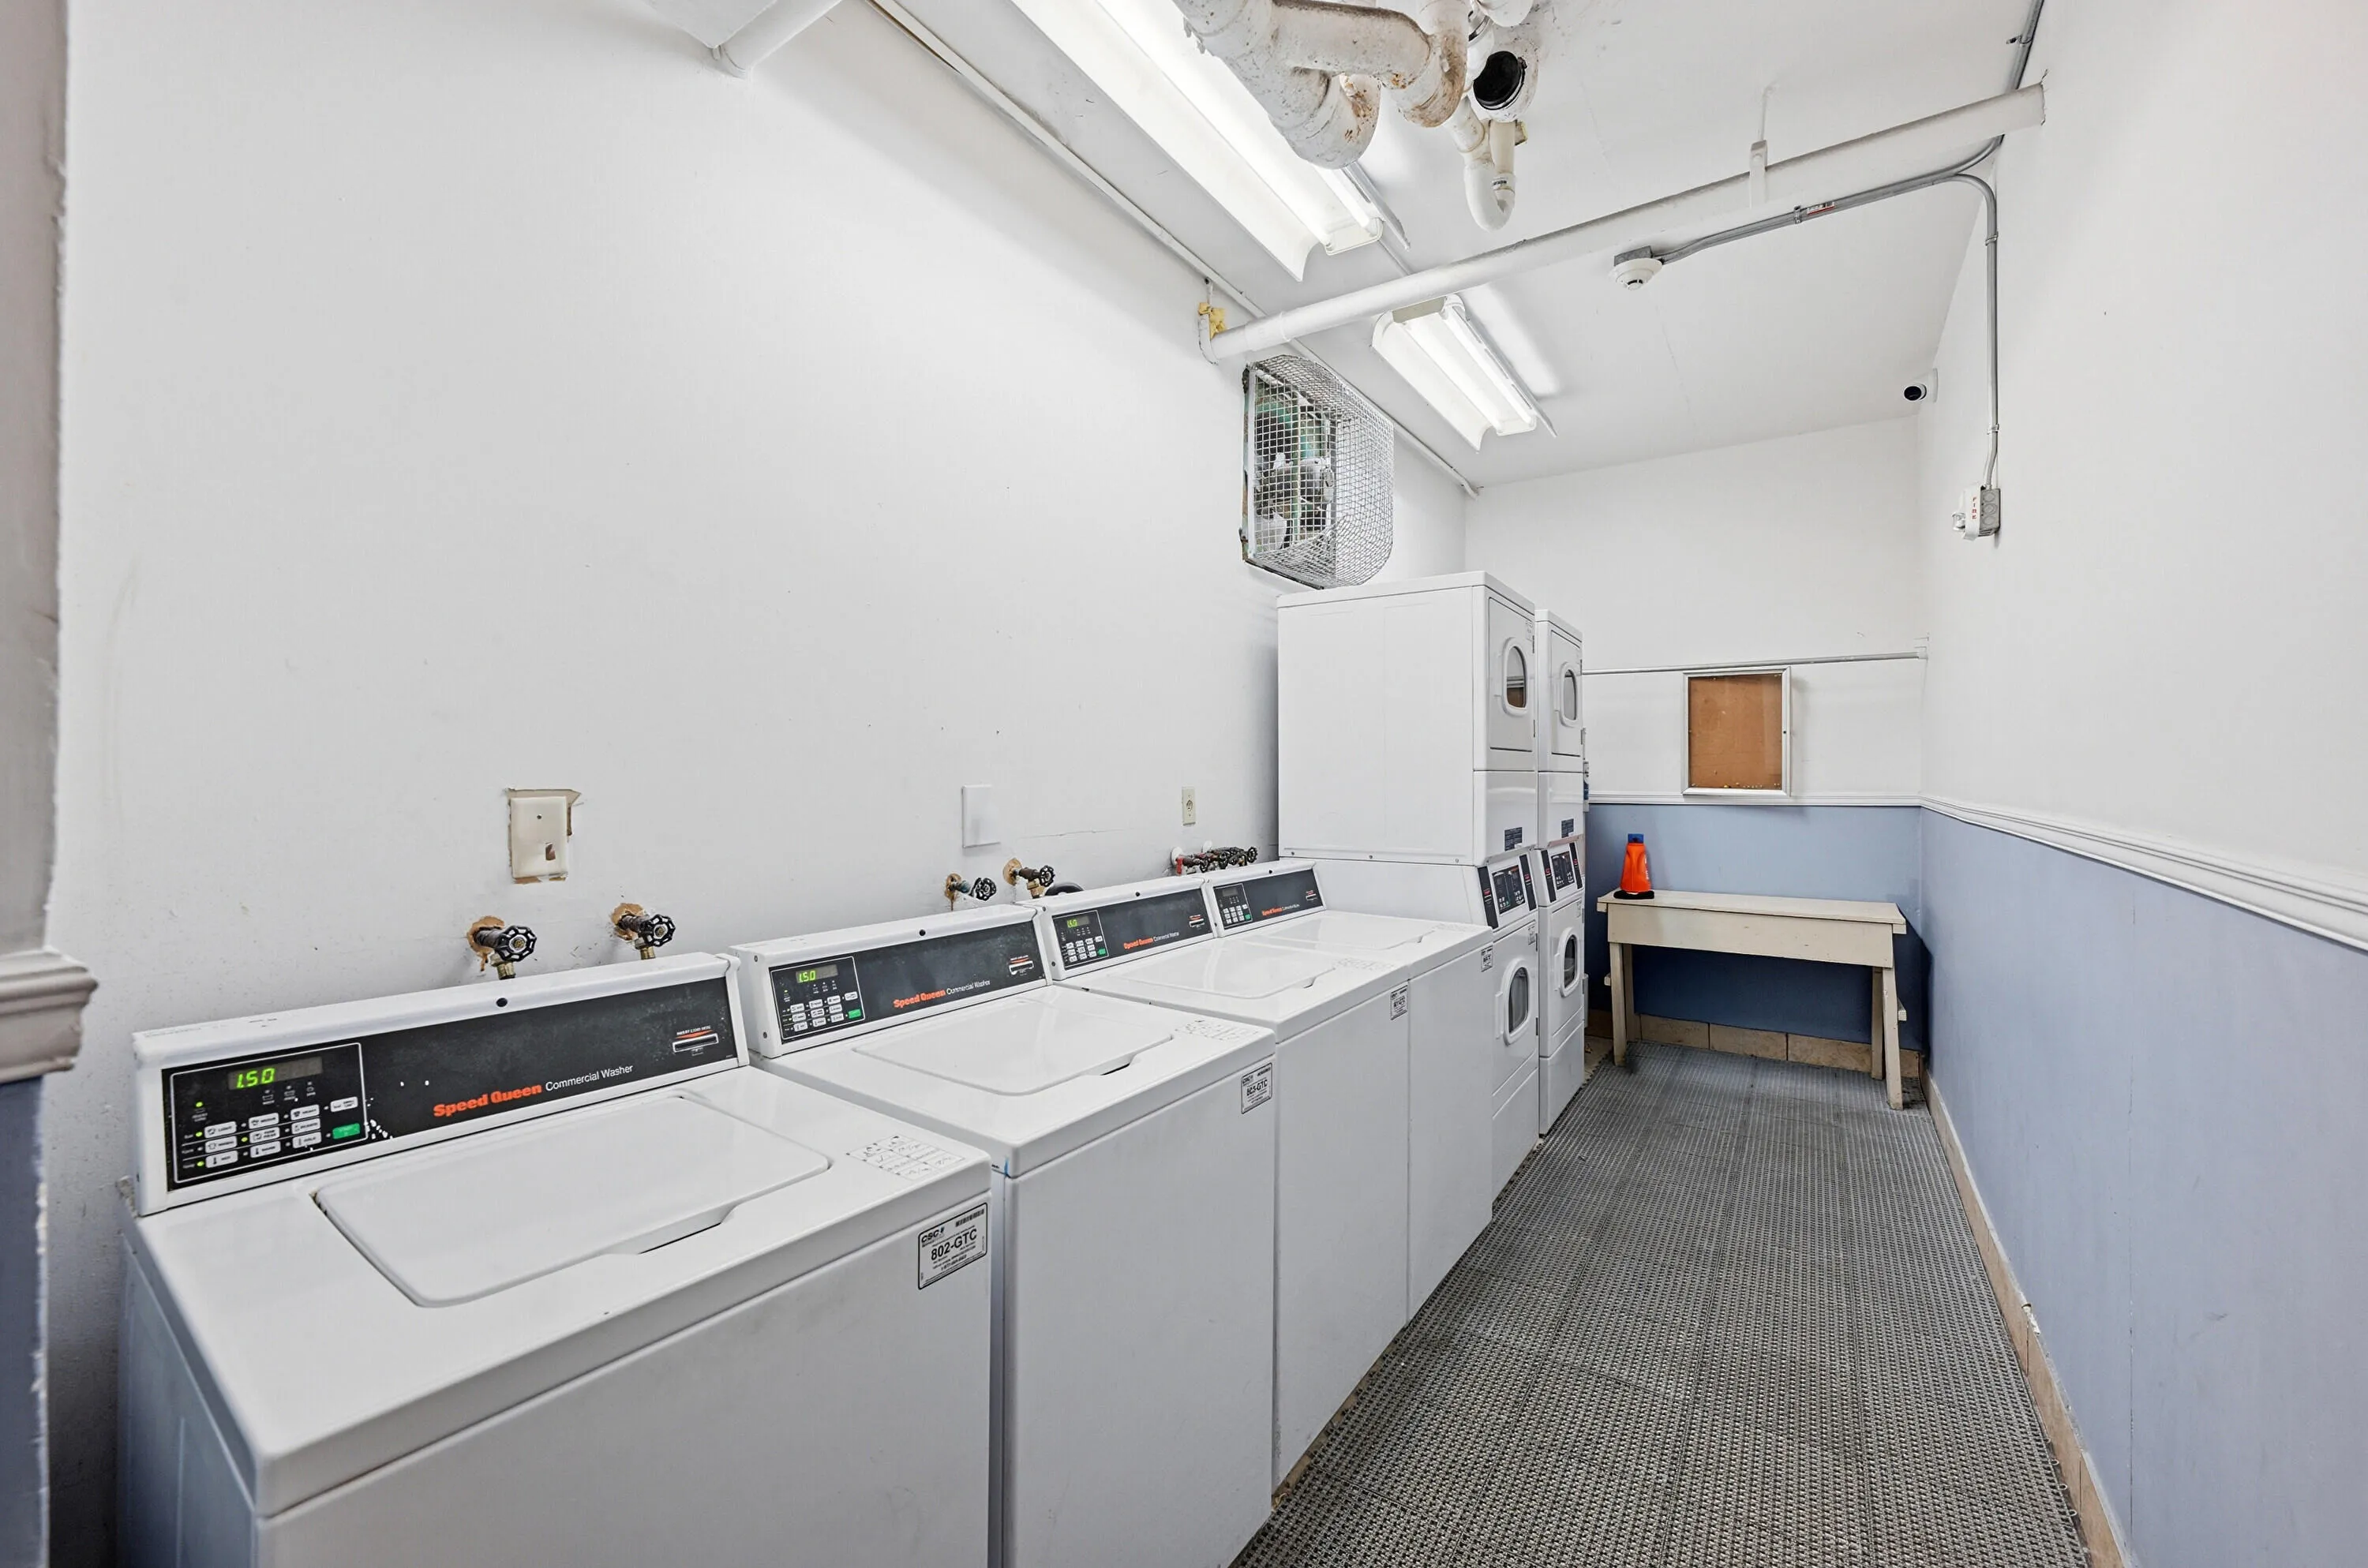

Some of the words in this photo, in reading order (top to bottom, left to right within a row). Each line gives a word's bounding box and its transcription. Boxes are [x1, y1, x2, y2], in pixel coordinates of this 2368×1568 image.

[894, 994, 920, 1008] Speed
[920, 990, 946, 1001] Queen
[433, 1094, 489, 1117] Speed
[491, 1084, 542, 1103] Queen
[545, 1072, 600, 1092] Commercial
[601, 1065, 633, 1080] Washer
[921, 1229, 939, 1243] CSC
[931, 1229, 977, 1260] 802-GTC
